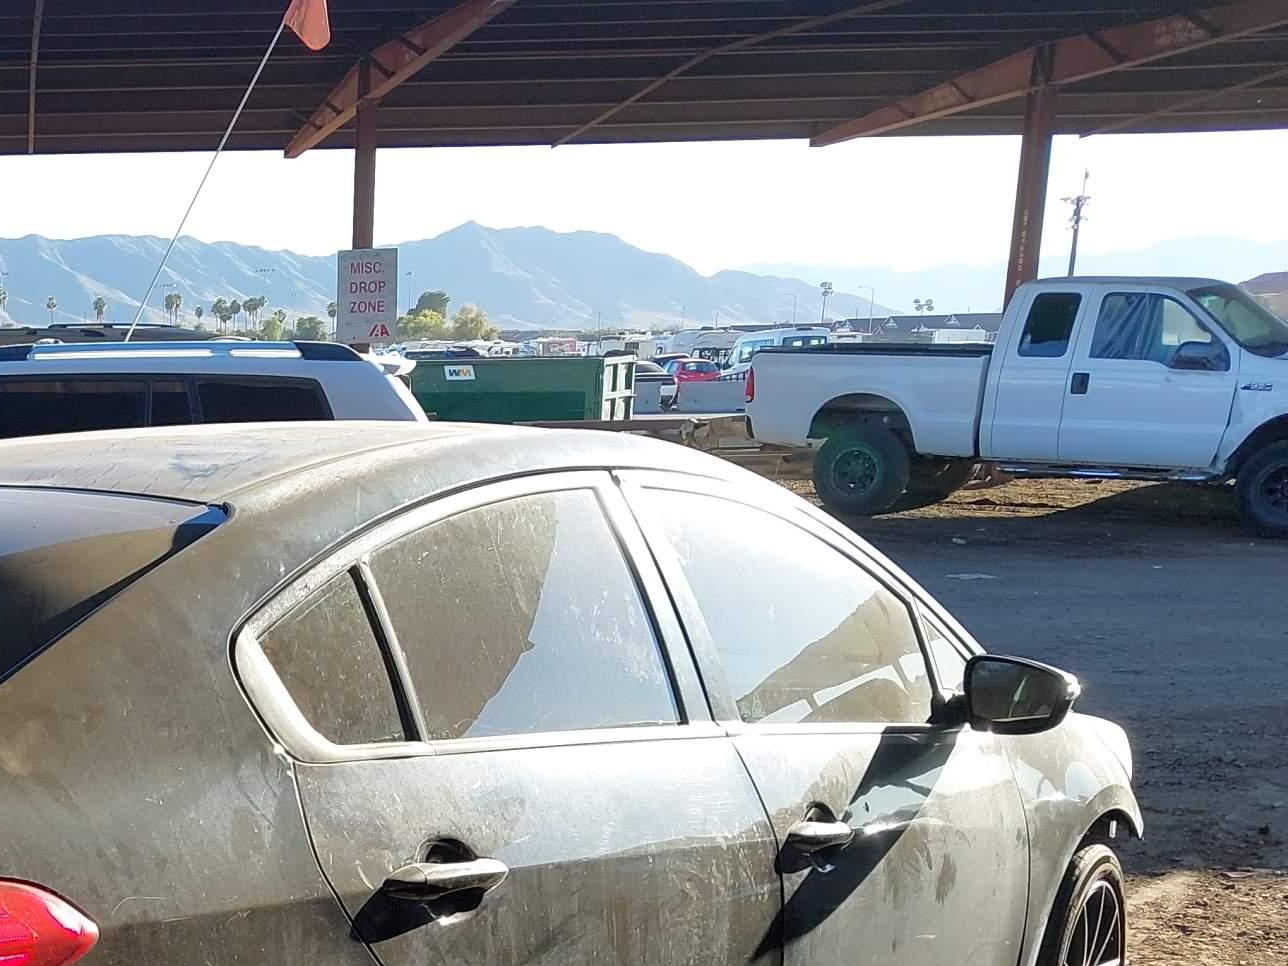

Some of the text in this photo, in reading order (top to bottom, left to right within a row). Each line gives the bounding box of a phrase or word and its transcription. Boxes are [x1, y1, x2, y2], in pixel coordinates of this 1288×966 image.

[350, 261, 385, 274] MISC.
[349, 280, 386, 294] DROP
[349, 300, 385, 313] ZONE
[448, 368, 472, 377] WM
